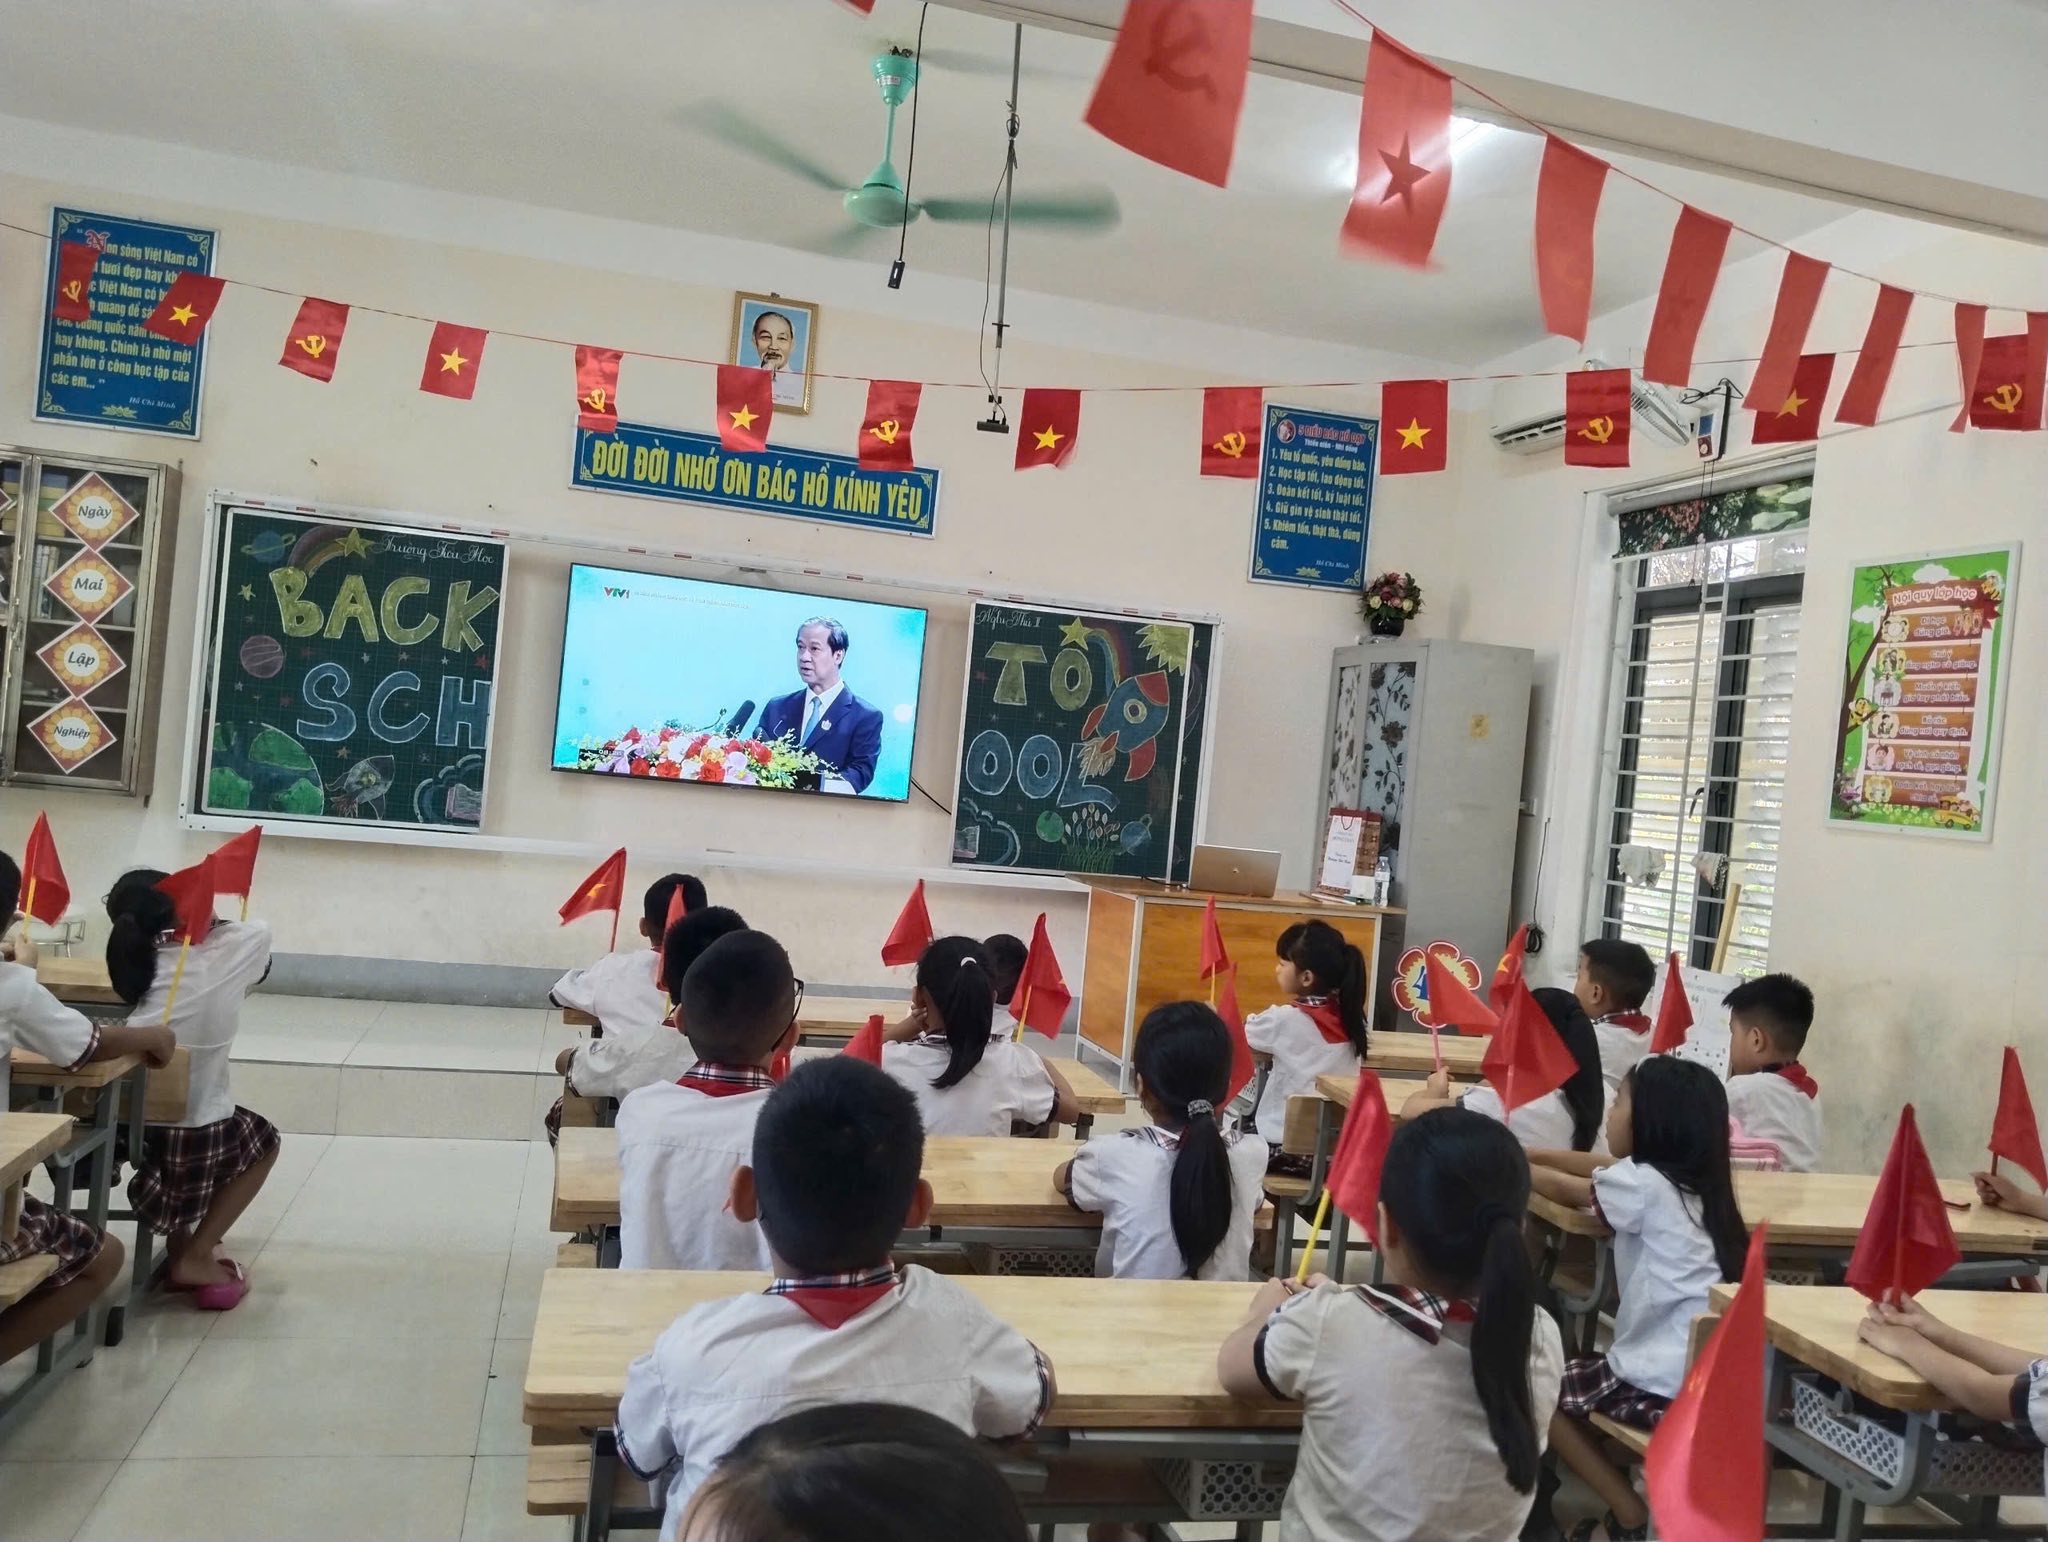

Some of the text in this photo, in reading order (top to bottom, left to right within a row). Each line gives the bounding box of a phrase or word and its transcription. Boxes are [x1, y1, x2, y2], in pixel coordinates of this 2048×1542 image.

[120, 243, 142, 260] sông
[144, 246, 162, 264] Việt
[164, 249, 185, 265] Nam
[186, 253, 198, 267] có
[101, 261, 120, 275] tươi
[123, 264, 142, 281] đẹp
[145, 267, 163, 283] hay
[100, 279, 118, 297] Việt
[120, 283, 142, 298] Nam
[145, 286, 156, 300] có
[98, 300, 126, 317] quang
[128, 301, 141, 317] để
[105, 318, 127, 334] quốc
[55, 332, 192, 365] hay không. Chính là nhờ một
[53, 350, 190, 383] phần lớn ở công học tập của
[51, 371, 70, 386] các
[156, 400, 176, 409] Minh
[1272, 447, 1278, 459] 1.
[1280, 448, 1292, 461] Yêu
[1321, 454, 1334, 467] yêu
[593, 432, 923, 522] ĐỜI ĐỜI NHỚ ƠN BÁC HỒ KÍNH YÊU
[1269, 465, 1276, 477] 2.
[1278, 466, 1292, 480] Học
[1294, 468, 1306, 482] tập
[1321, 471, 1333, 485] lao
[1334, 474, 1352, 488] động
[1267, 482, 1275, 494] 3.
[1276, 483, 1296, 497] Đoàn
[1297, 485, 1310, 499] kết
[1336, 491, 1351, 506] luật
[78, 505, 112, 520] Ngày
[1266, 500, 1273, 512] 4.
[1275, 501, 1288, 514] Giữ
[1290, 503, 1302, 517] gìn
[1304, 505, 1313, 519] vệ
[1314, 507, 1331, 520] sinh
[1333, 509, 1348, 524] thật
[1264, 518, 1271, 530] 5.
[1272, 519, 1296, 533] Khiêm
[383, 533, 427, 563] Trường
[74, 577, 104, 592] Mai
[604, 586, 630, 599] VTV1
[1892, 585, 1978, 606] Nội quy lớp học
[268, 566, 500, 653] BACK
[68, 650, 95, 668] Lập
[985, 641, 1092, 712] TO
[296, 662, 492, 749] SCH
[54, 725, 91, 739] Nghiệp
[966, 729, 1120, 813] OOL
